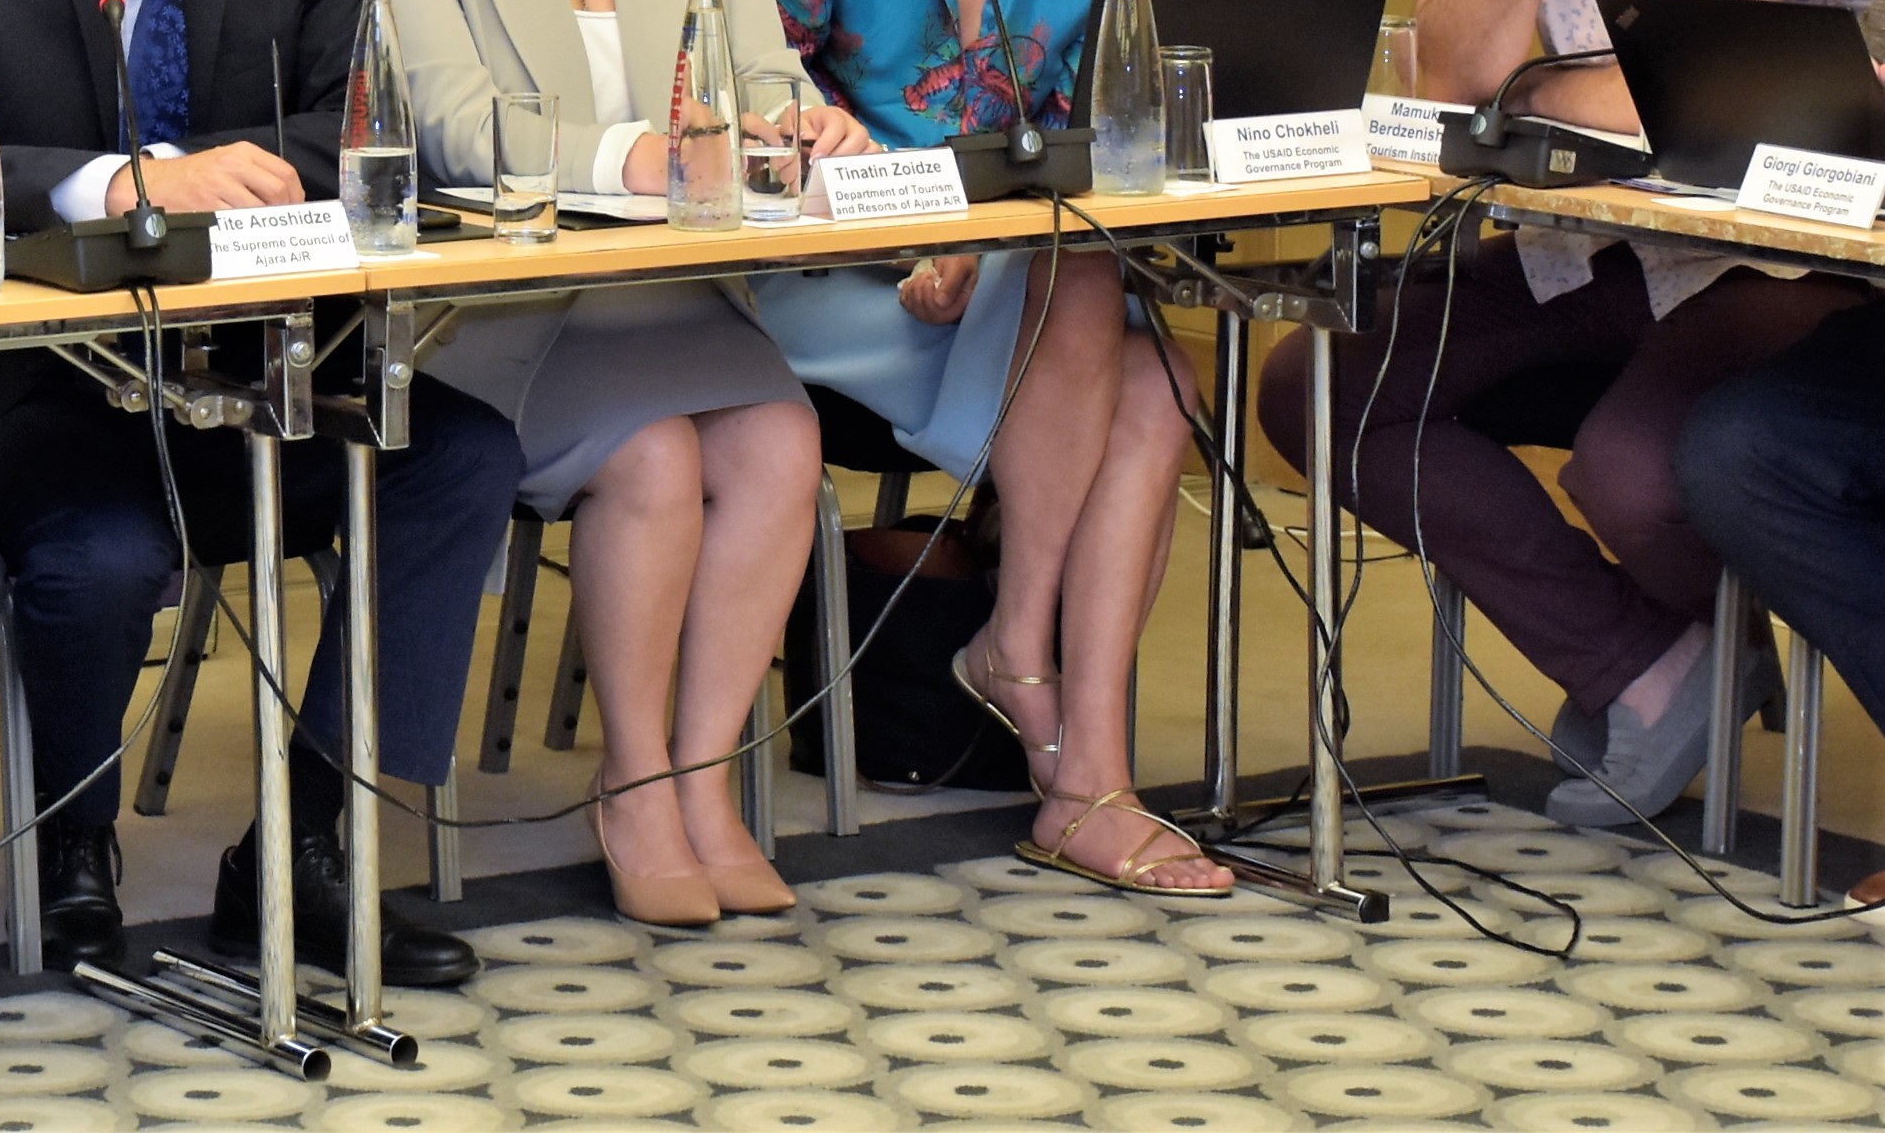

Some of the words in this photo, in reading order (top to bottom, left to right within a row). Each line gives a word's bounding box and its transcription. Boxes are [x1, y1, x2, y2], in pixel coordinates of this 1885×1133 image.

[1391, 102, 1439, 120] Mamuk
[1237, 125, 1271, 142] Nino
[1275, 120, 1340, 139] Chokheli
[1369, 120, 1443, 143] Berdzenish
[1243, 151, 1260, 161] The
[1263, 148, 1293, 159] USAID
[1295, 144, 1340, 156] Economic
[1410, 149, 1439, 163] Instit
[835, 164, 888, 181] Tinatin
[891, 161, 942, 176] Zoidze
[1245, 160, 1301, 174] Governance
[1304, 158, 1342, 171] Program
[1763, 155, 1802, 177] Giorgi
[1803, 162, 1877, 186] Giorgobiani
[835, 187, 896, 202] Department
[899, 185, 909, 196] of
[911, 183, 954, 194] Tourism
[1768, 180, 1783, 191] The
[1785, 182, 1811, 196] USAID
[1813, 188, 1854, 203] Economic
[836, 205, 855, 215] and
[858, 201, 898, 213] Resorts
[901, 199, 911, 209] of
[914, 198, 941, 210] Ajara
[943, 195, 962, 206] A/R
[1763, 194, 1811, 210] Governance
[1813, 202, 1849, 216] Program
[215, 217, 244, 231] Tite
[250, 210, 332, 229] Aroshidze
[233, 239, 286, 252] Supreme
[289, 234, 335, 246] Council
[338, 232, 350, 243] of
[255, 255, 287, 267] Ajara
[290, 251, 311, 263] A/R
